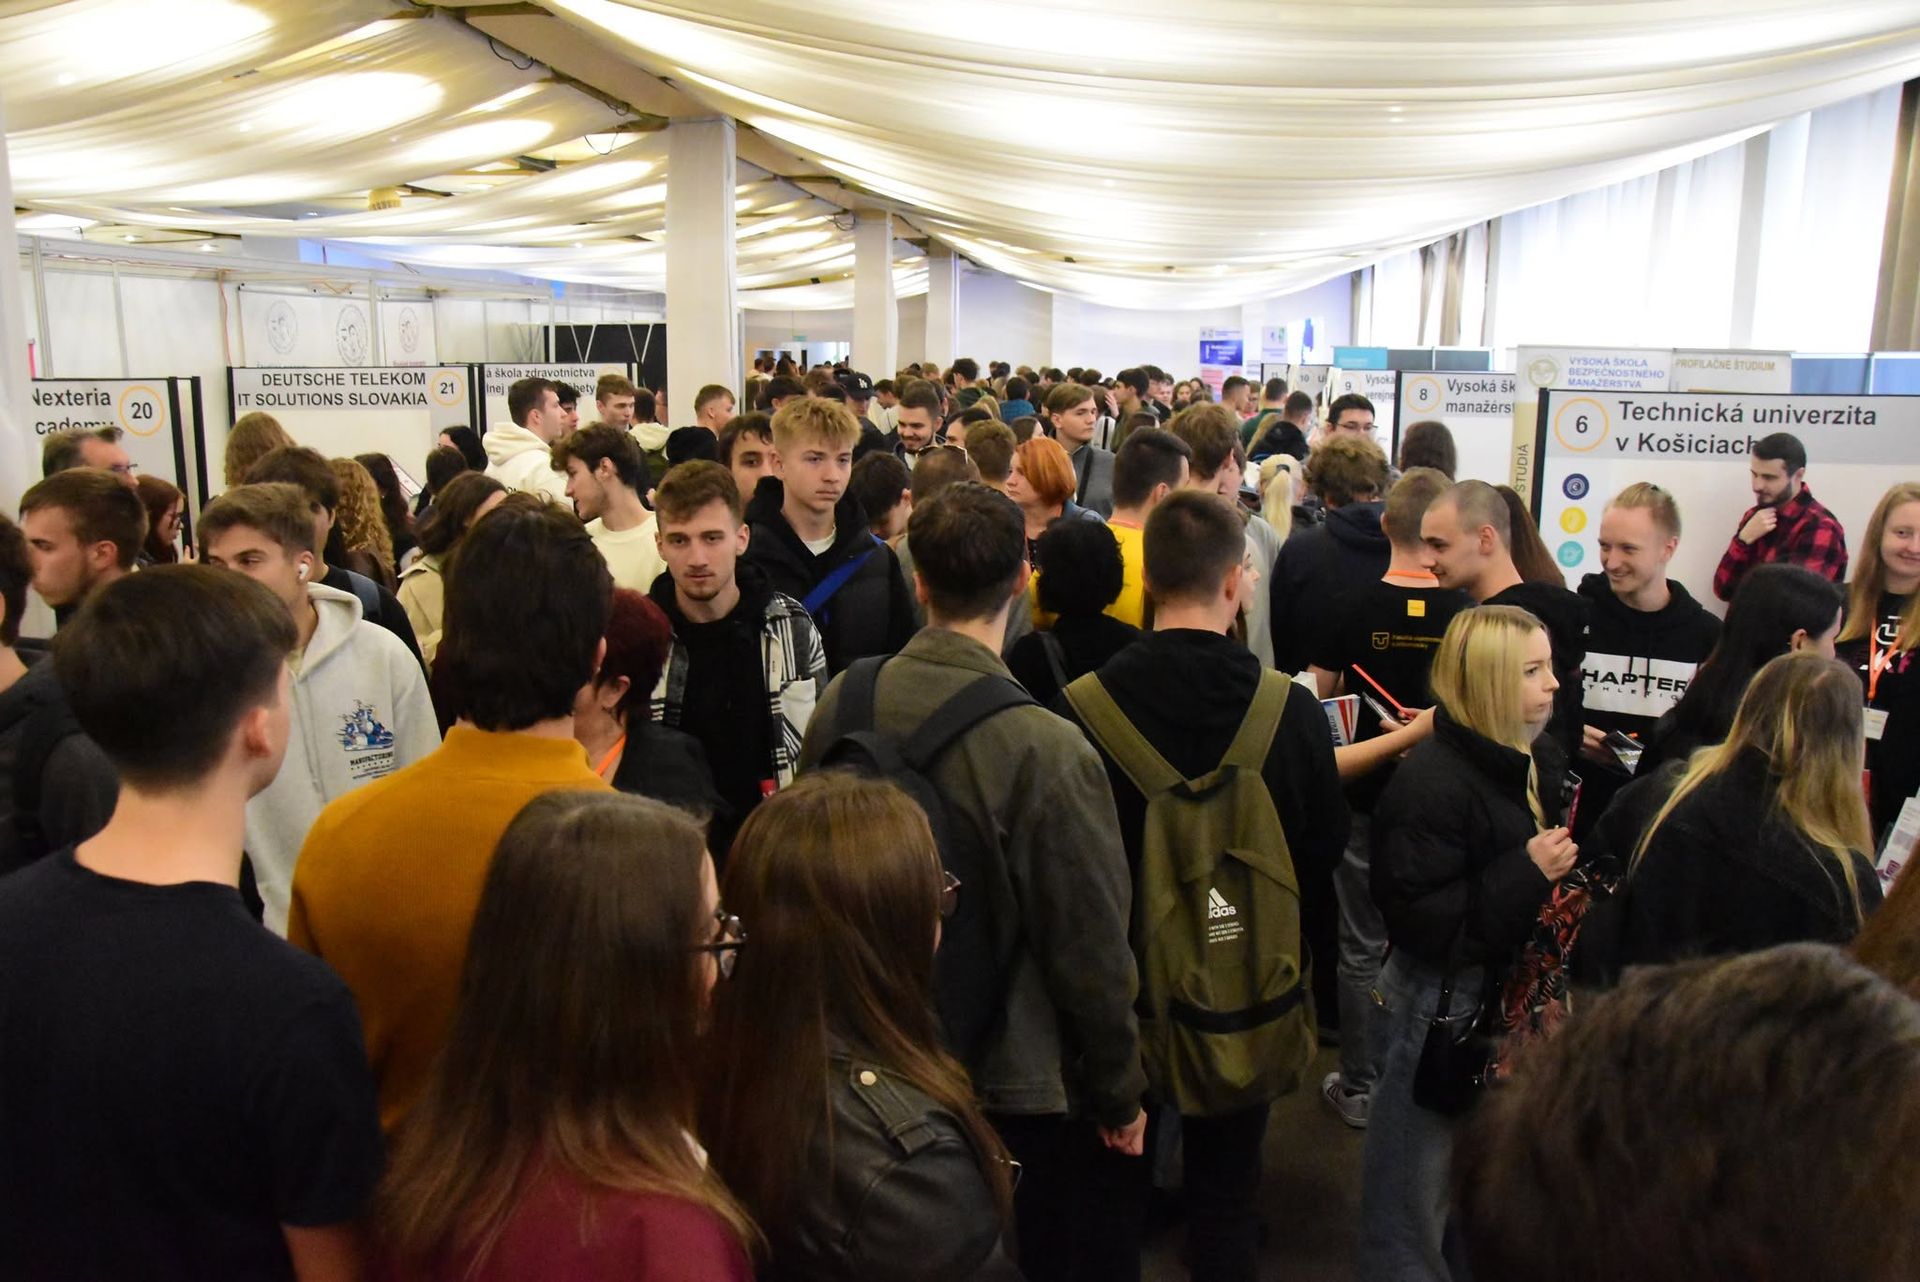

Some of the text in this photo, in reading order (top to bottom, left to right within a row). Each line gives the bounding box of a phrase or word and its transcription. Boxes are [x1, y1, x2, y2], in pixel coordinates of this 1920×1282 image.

[262, 372, 426, 387] DEUTSCHE TELEKOM
[495, 368, 522, 378] škola
[440, 382, 455, 394] 21
[486, 384, 505, 395] lnej
[1345, 381, 1352, 391] 9
[1447, 378, 1496, 396] Vysoká
[238, 392, 428, 406] IT SOLUTIONS SLOVAKIA
[1419, 388, 1428, 401] 8
[131, 402, 153, 419] 20
[1619, 400, 1877, 426] Technická univerzita
[1575, 415, 1588, 433] 6
[1615, 436, 1629, 451] v
[1581, 668, 1690, 692] HAPTER
